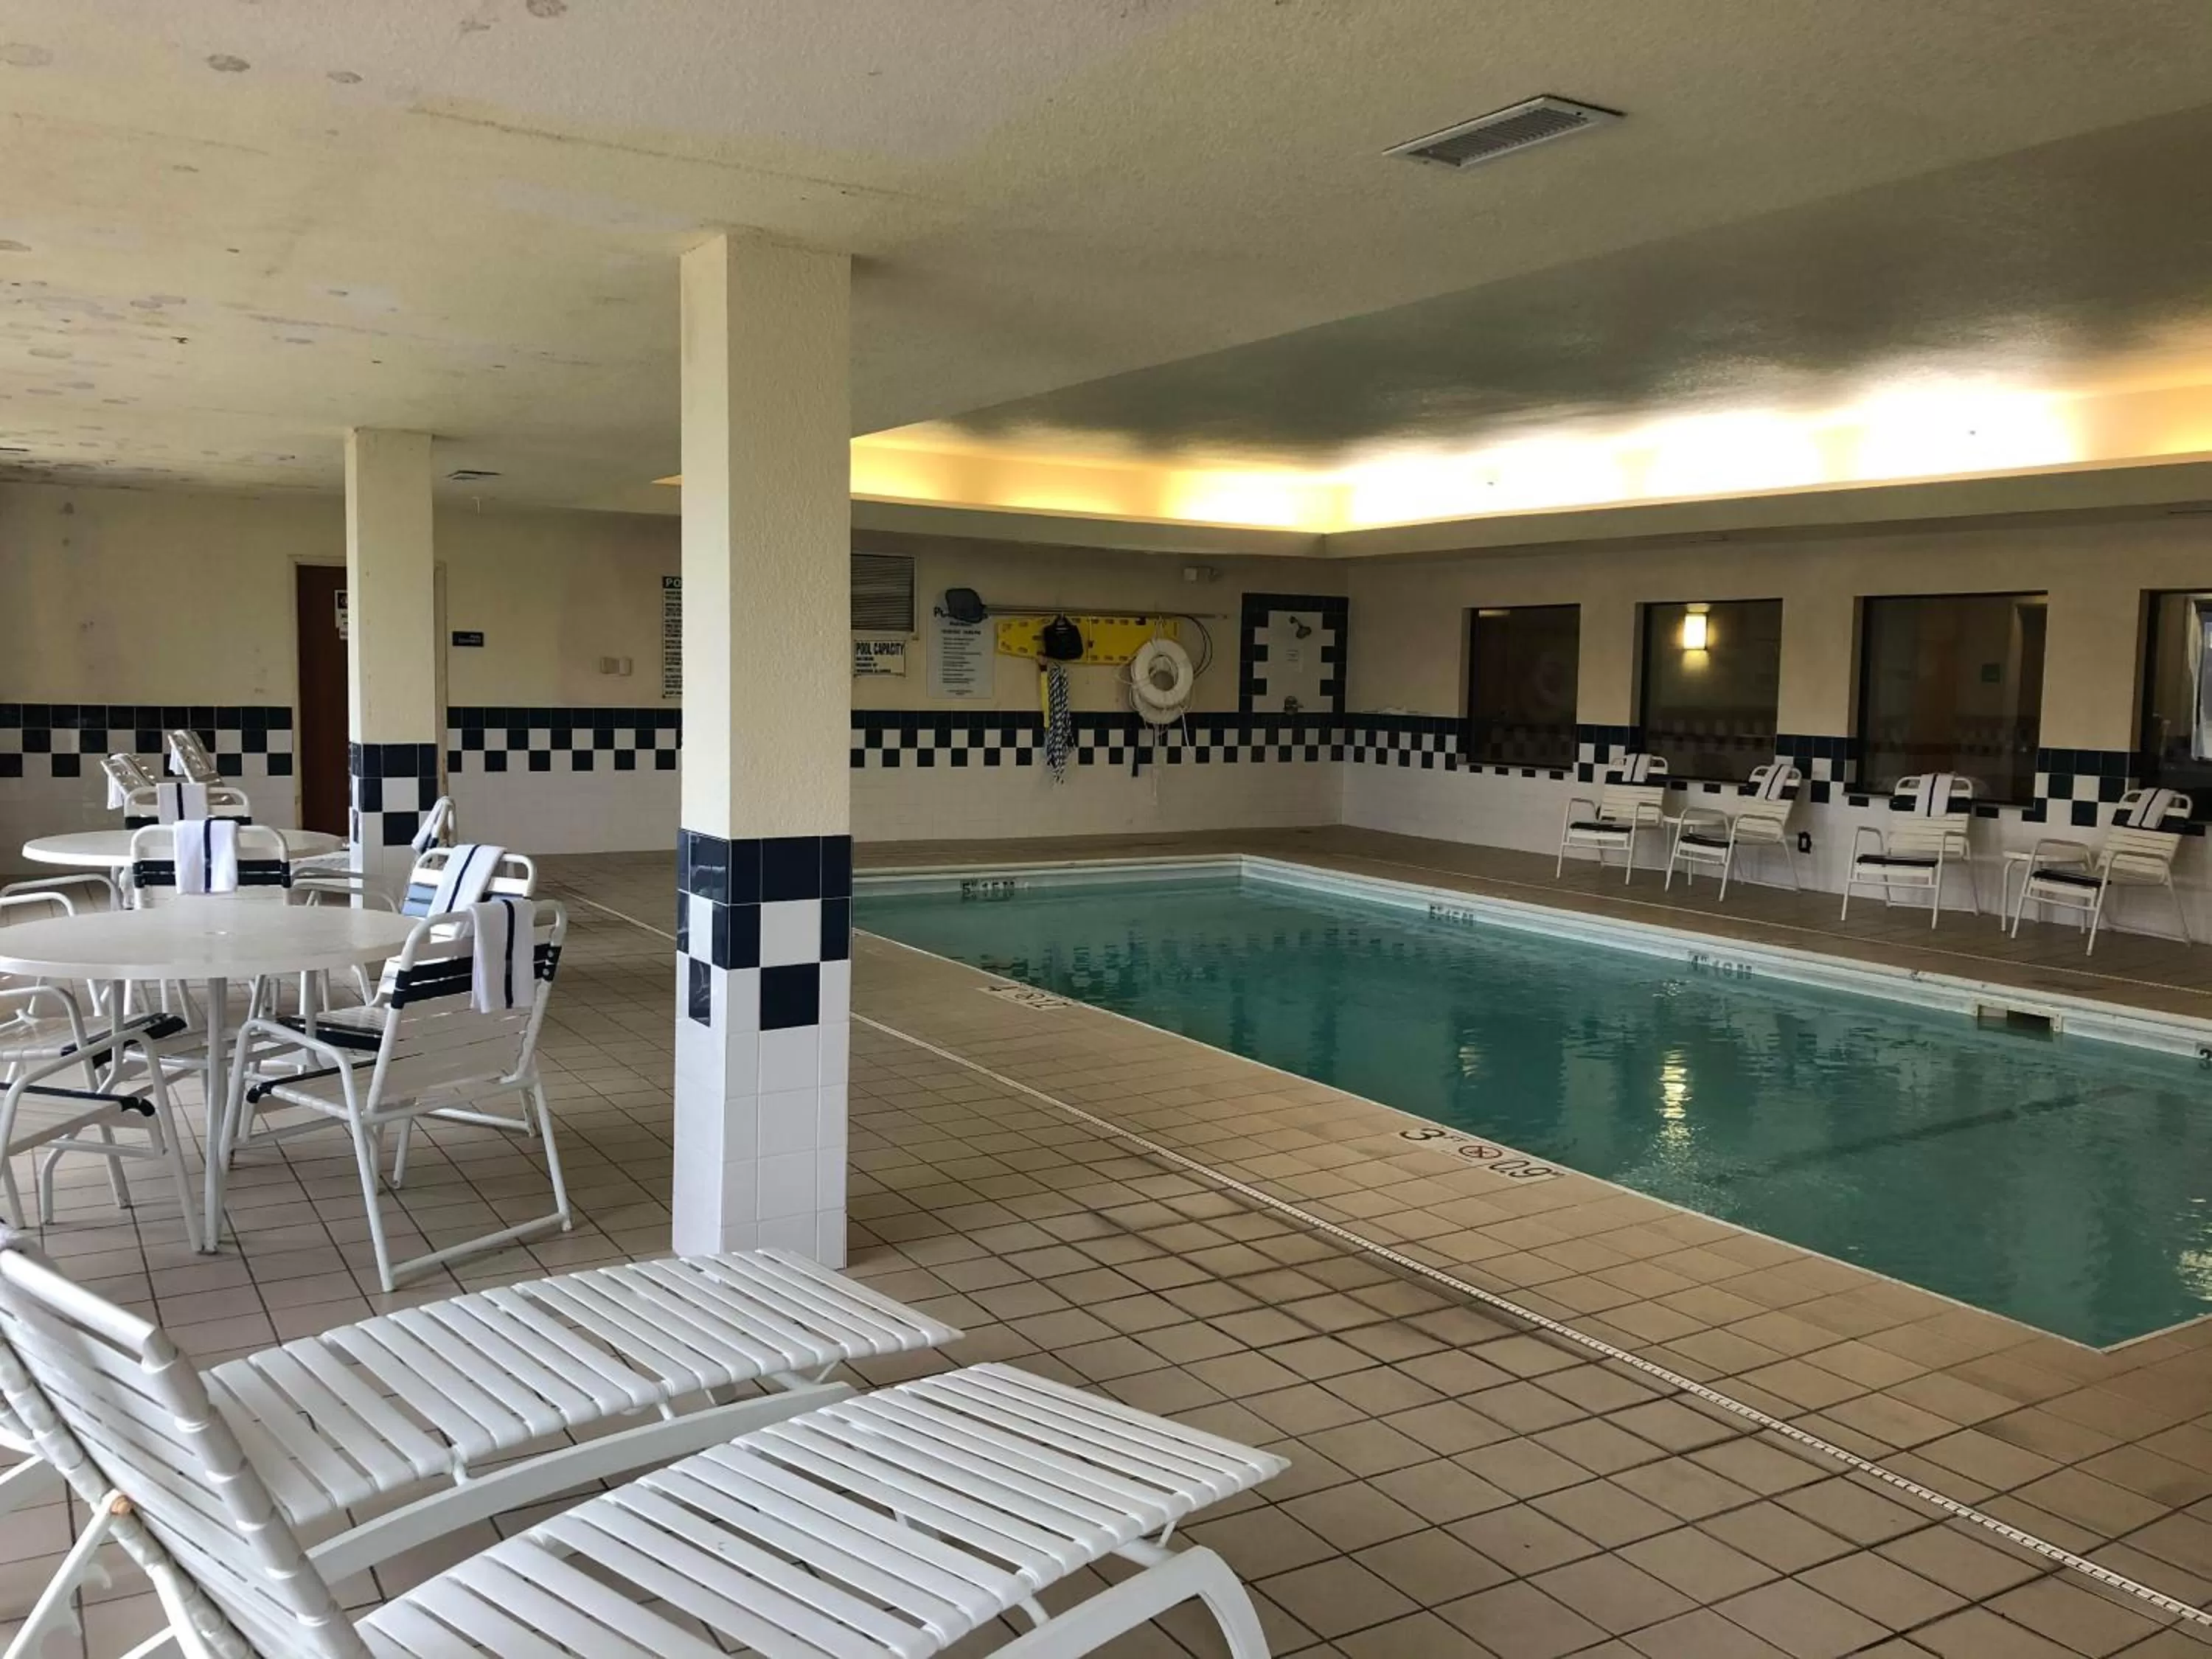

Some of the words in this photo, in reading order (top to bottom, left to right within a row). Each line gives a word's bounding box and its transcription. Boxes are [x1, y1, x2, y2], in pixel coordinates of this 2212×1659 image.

[855, 642, 872, 655] POOL
[874, 642, 903, 655] CAPACITY
[1399, 1127, 1446, 1141] 3
